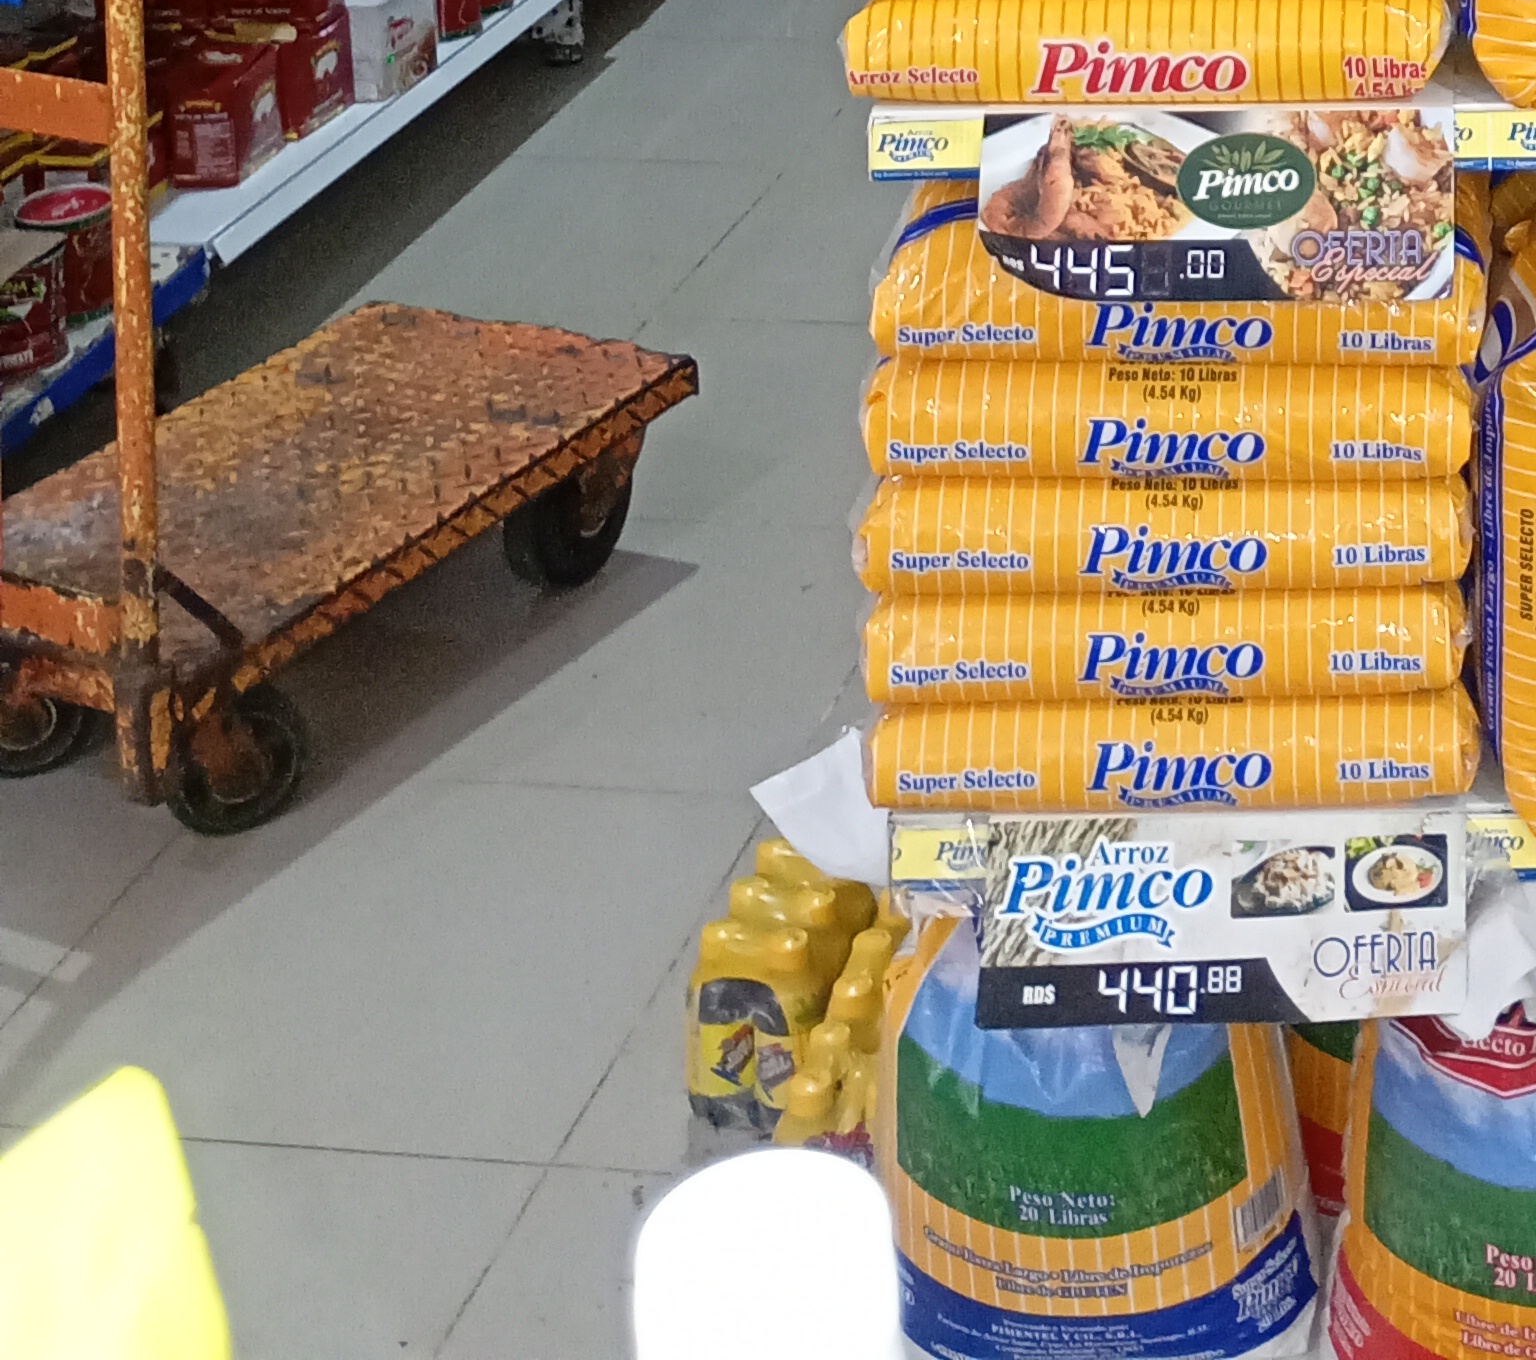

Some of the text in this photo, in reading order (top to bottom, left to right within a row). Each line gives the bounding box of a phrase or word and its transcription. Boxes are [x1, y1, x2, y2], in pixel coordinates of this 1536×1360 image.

[1032, 42, 1248, 94] Pimco
[1196, 167, 1300, 202] Pimco
[1291, 231, 1424, 267] OFERTA
[1311, 249, 1431, 291] Especial
[1087, 303, 1273, 349] Pimco
[1079, 418, 1266, 463] Pimco
[892, 552, 1029, 572] Super Selecto
[1080, 526, 1268, 575] Pimco
[1334, 544, 1426, 565] 10 Libras
[1087, 742, 1272, 791] Pimco
[1094, 842, 1169, 866] Arroz
[1002, 858, 1213, 914] Pimco
[1044, 917, 1165, 945] PREMIUM
[1313, 931, 1436, 978] OFERTA
[1022, 986, 1055, 1004] RD$
[1485, 1245, 1532, 1271] Peso
[1493, 1270, 1517, 1289] 20
